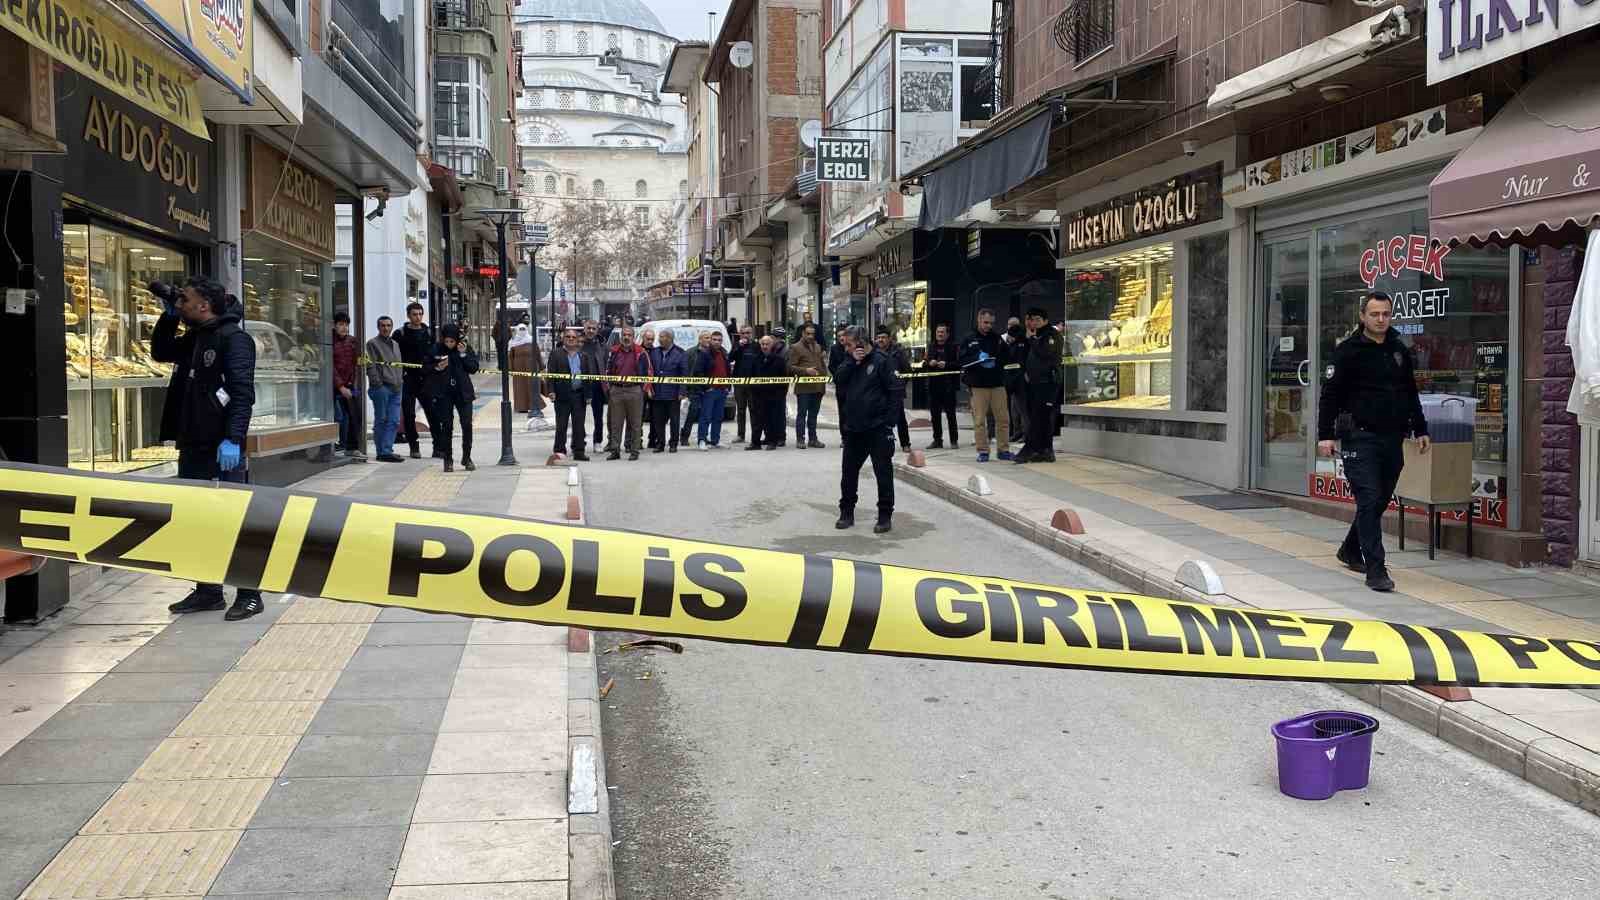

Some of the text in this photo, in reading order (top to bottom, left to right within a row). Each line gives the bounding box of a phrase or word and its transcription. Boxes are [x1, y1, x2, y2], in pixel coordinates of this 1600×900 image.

[133, 56, 156, 102] ET
[84, 96, 199, 194] AYDOĞDU
[819, 141, 869, 158] TERZİ
[282, 162, 322, 211] EROL
[823, 162, 867, 179] EROL
[1502, 163, 1592, 199] Nur &
[1069, 179, 1197, 251] HÜSEYİN ÖZOĞLU
[1360, 234, 1451, 288] ÇİÇEK
[1360, 288, 1450, 319] ARET
[387, 522, 748, 622] POLİS
[914, 577, 1379, 665] GİRİLMEZ
